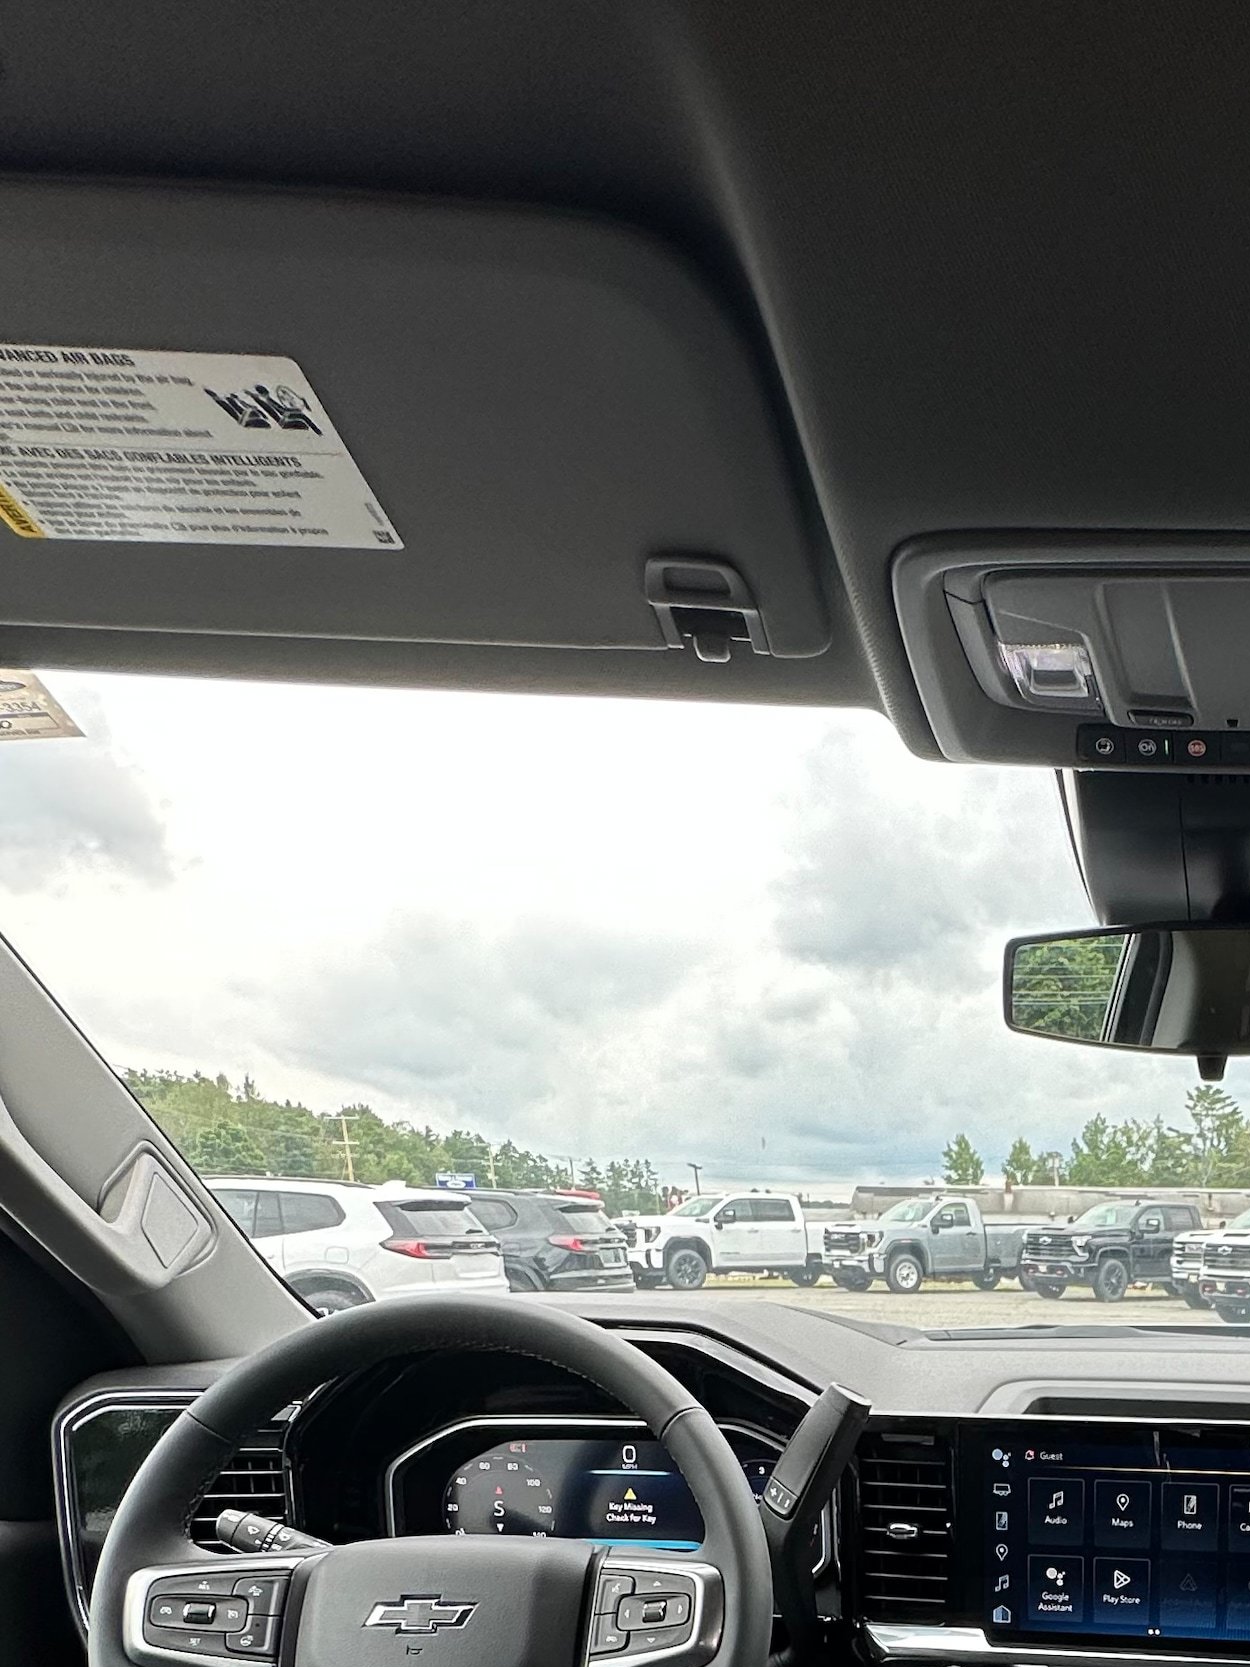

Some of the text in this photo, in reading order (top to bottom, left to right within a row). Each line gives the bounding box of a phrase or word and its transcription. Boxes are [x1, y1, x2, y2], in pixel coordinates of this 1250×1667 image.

[61, 351, 90, 365] AIR
[91, 352, 136, 367] BAGS
[622, 1444, 636, 1464] 0
[1040, 1451, 1063, 1461] Guest
[493, 1500, 505, 1517] S
[608, 1502, 653, 1513] Key Missing
[606, 1513, 657, 1525] Check for Key
[1044, 1515, 1067, 1525] Audio
[1111, 1518, 1134, 1529] Maps
[1177, 1520, 1202, 1530] Phone
[1041, 1592, 1070, 1604] Google
[1102, 1594, 1141, 1605] Play Store
[1038, 1602, 1073, 1613] Assistant
